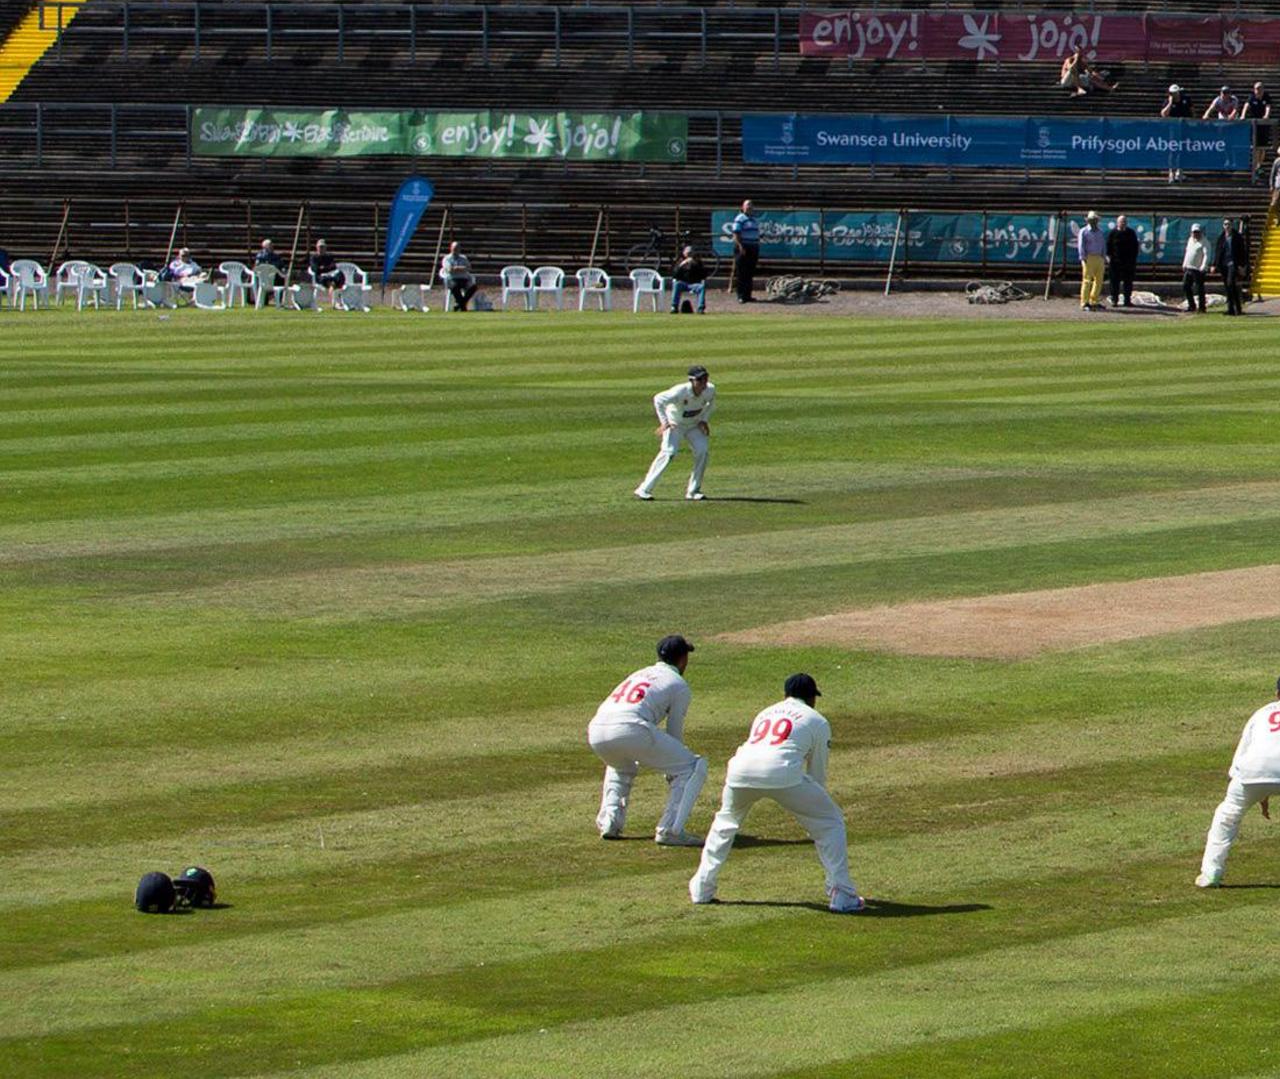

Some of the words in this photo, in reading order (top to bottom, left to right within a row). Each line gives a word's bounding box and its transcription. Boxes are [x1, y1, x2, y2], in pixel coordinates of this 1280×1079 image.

[813, 14, 919, 59] enjoy!
[441, 113, 516, 153] enjoy!
[816, 130, 888, 147] Swansea
[893, 132, 973, 152] University
[1071, 135, 1141, 154] Prifysgol
[1145, 135, 1227, 152] Abertawe
[612, 679, 651, 705] 46
[750, 717, 793, 746] 99
